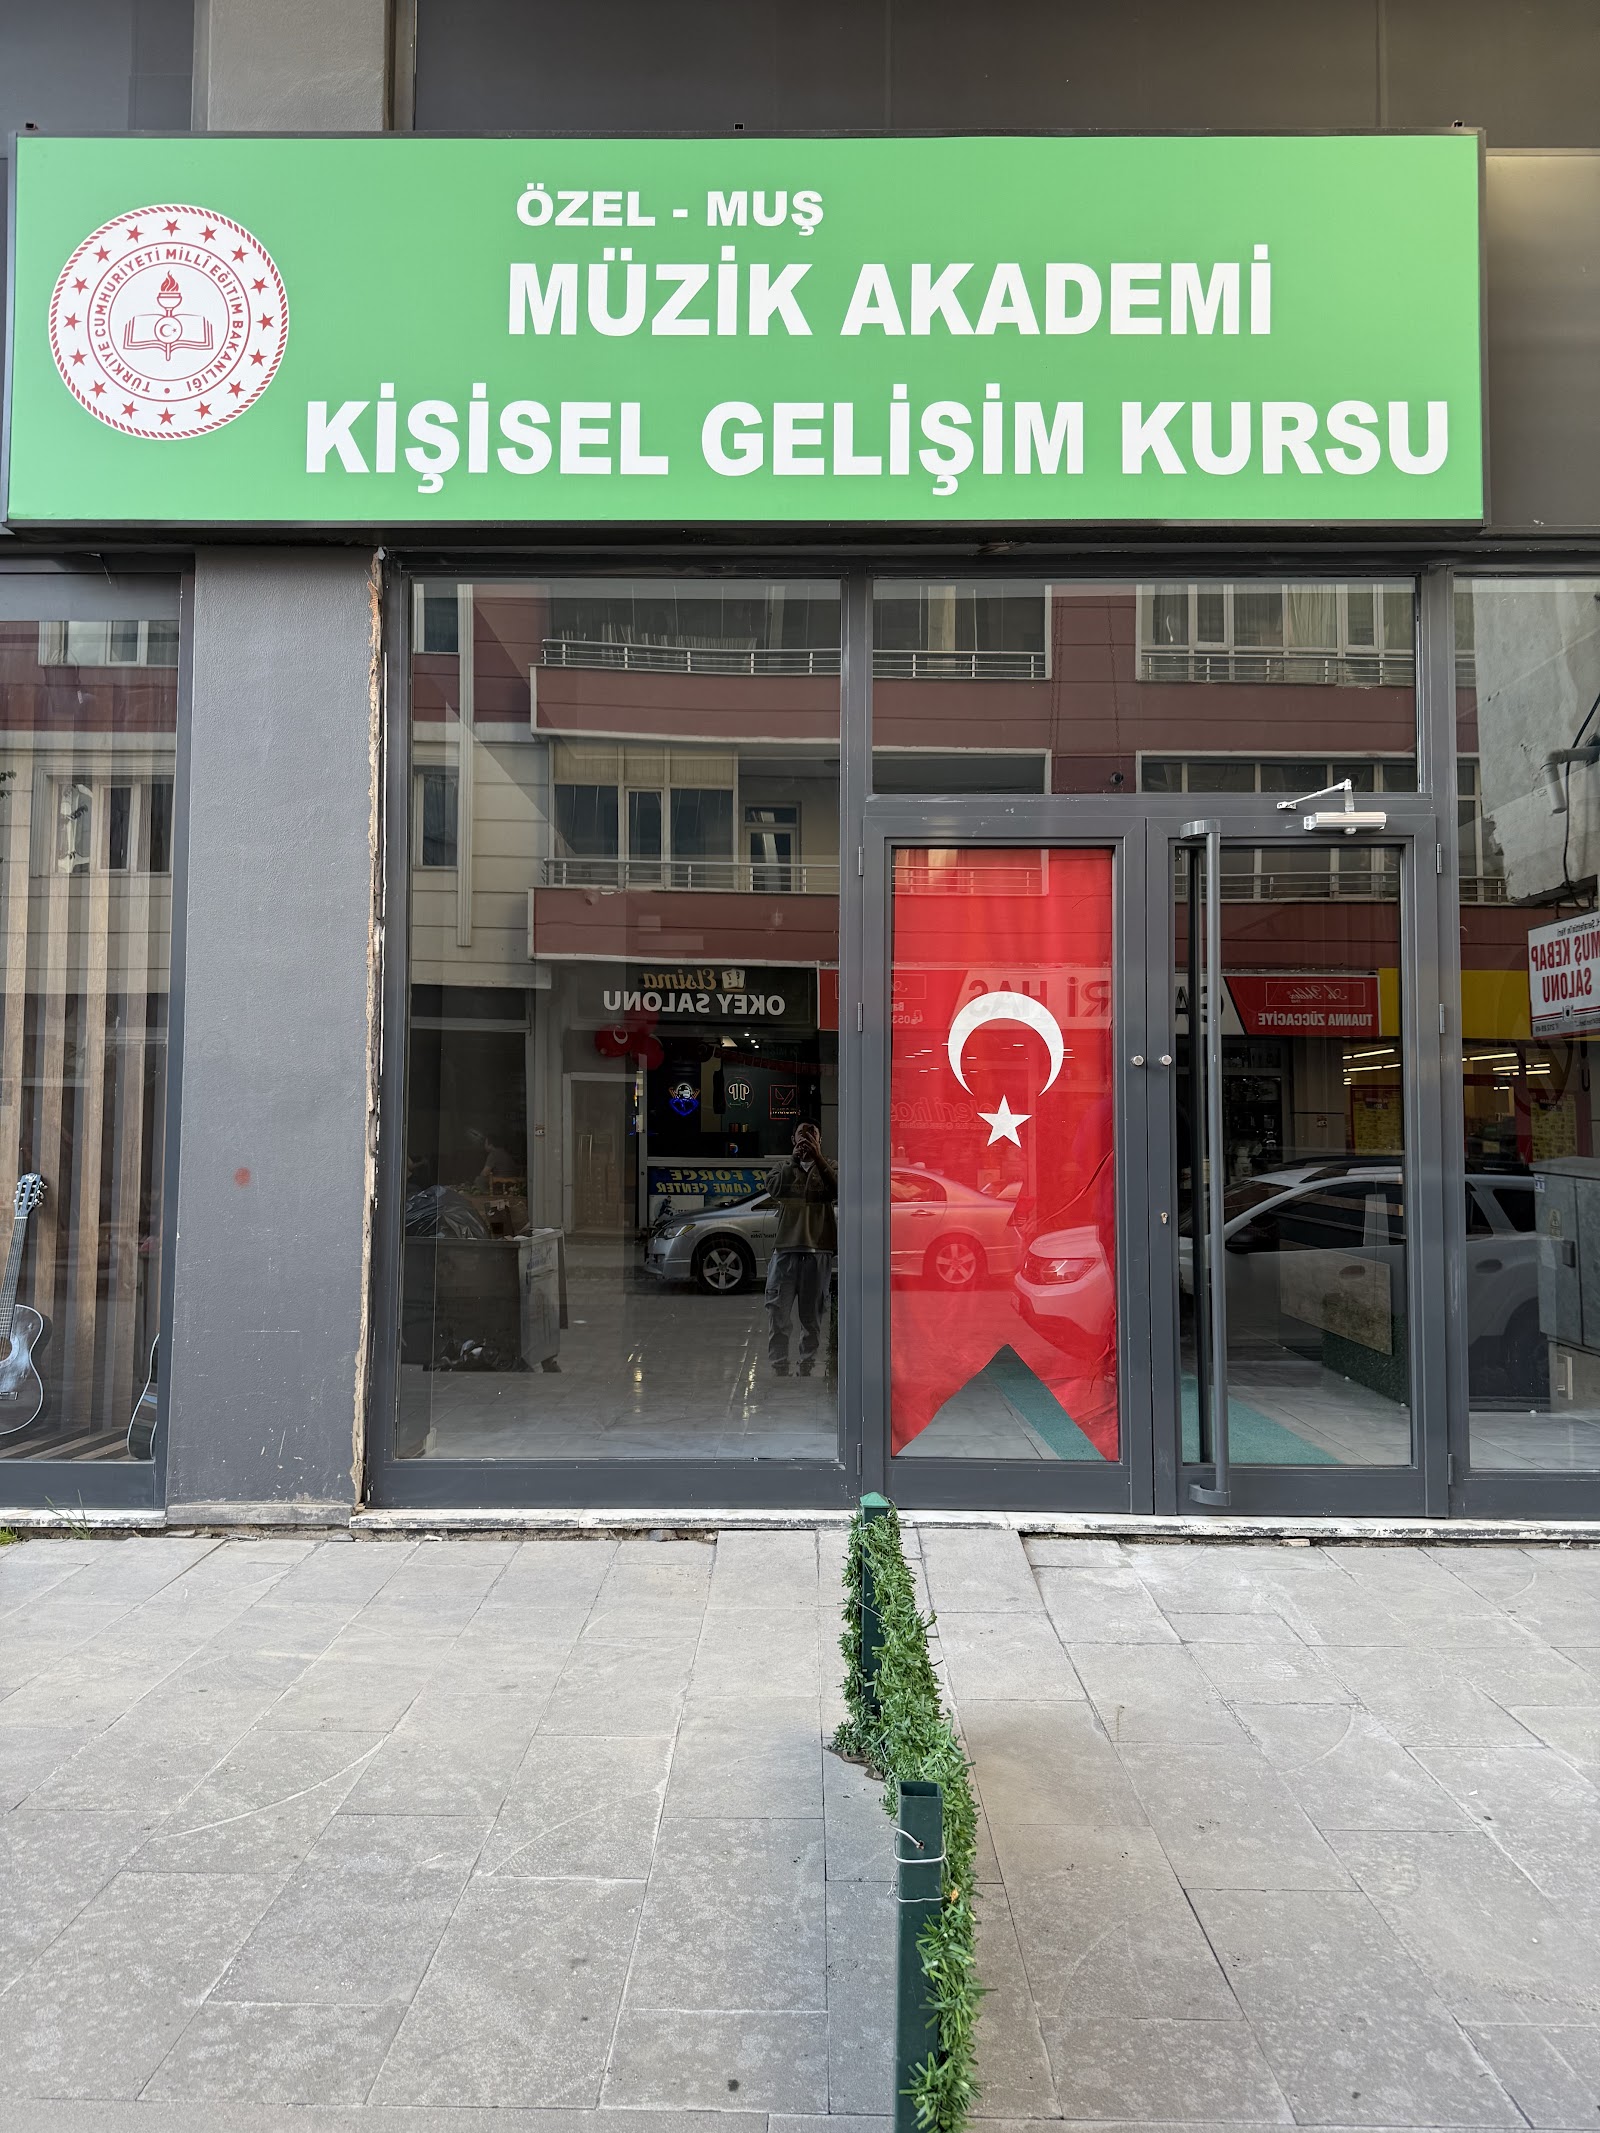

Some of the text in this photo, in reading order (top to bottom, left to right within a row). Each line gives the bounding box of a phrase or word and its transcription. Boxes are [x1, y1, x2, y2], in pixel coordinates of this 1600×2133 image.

[516, 182, 824, 239] ÖZEL - MUŞ
[94, 246, 244, 393] TÜRKİYE CUMHURİYETİ MİLLÎ EĞİTİM BAKANLIĞI
[508, 243, 1271, 336] MÜZİK AKADEMİ
[305, 382, 1449, 497] KİŞİSEL GELİŞİM KURSU
